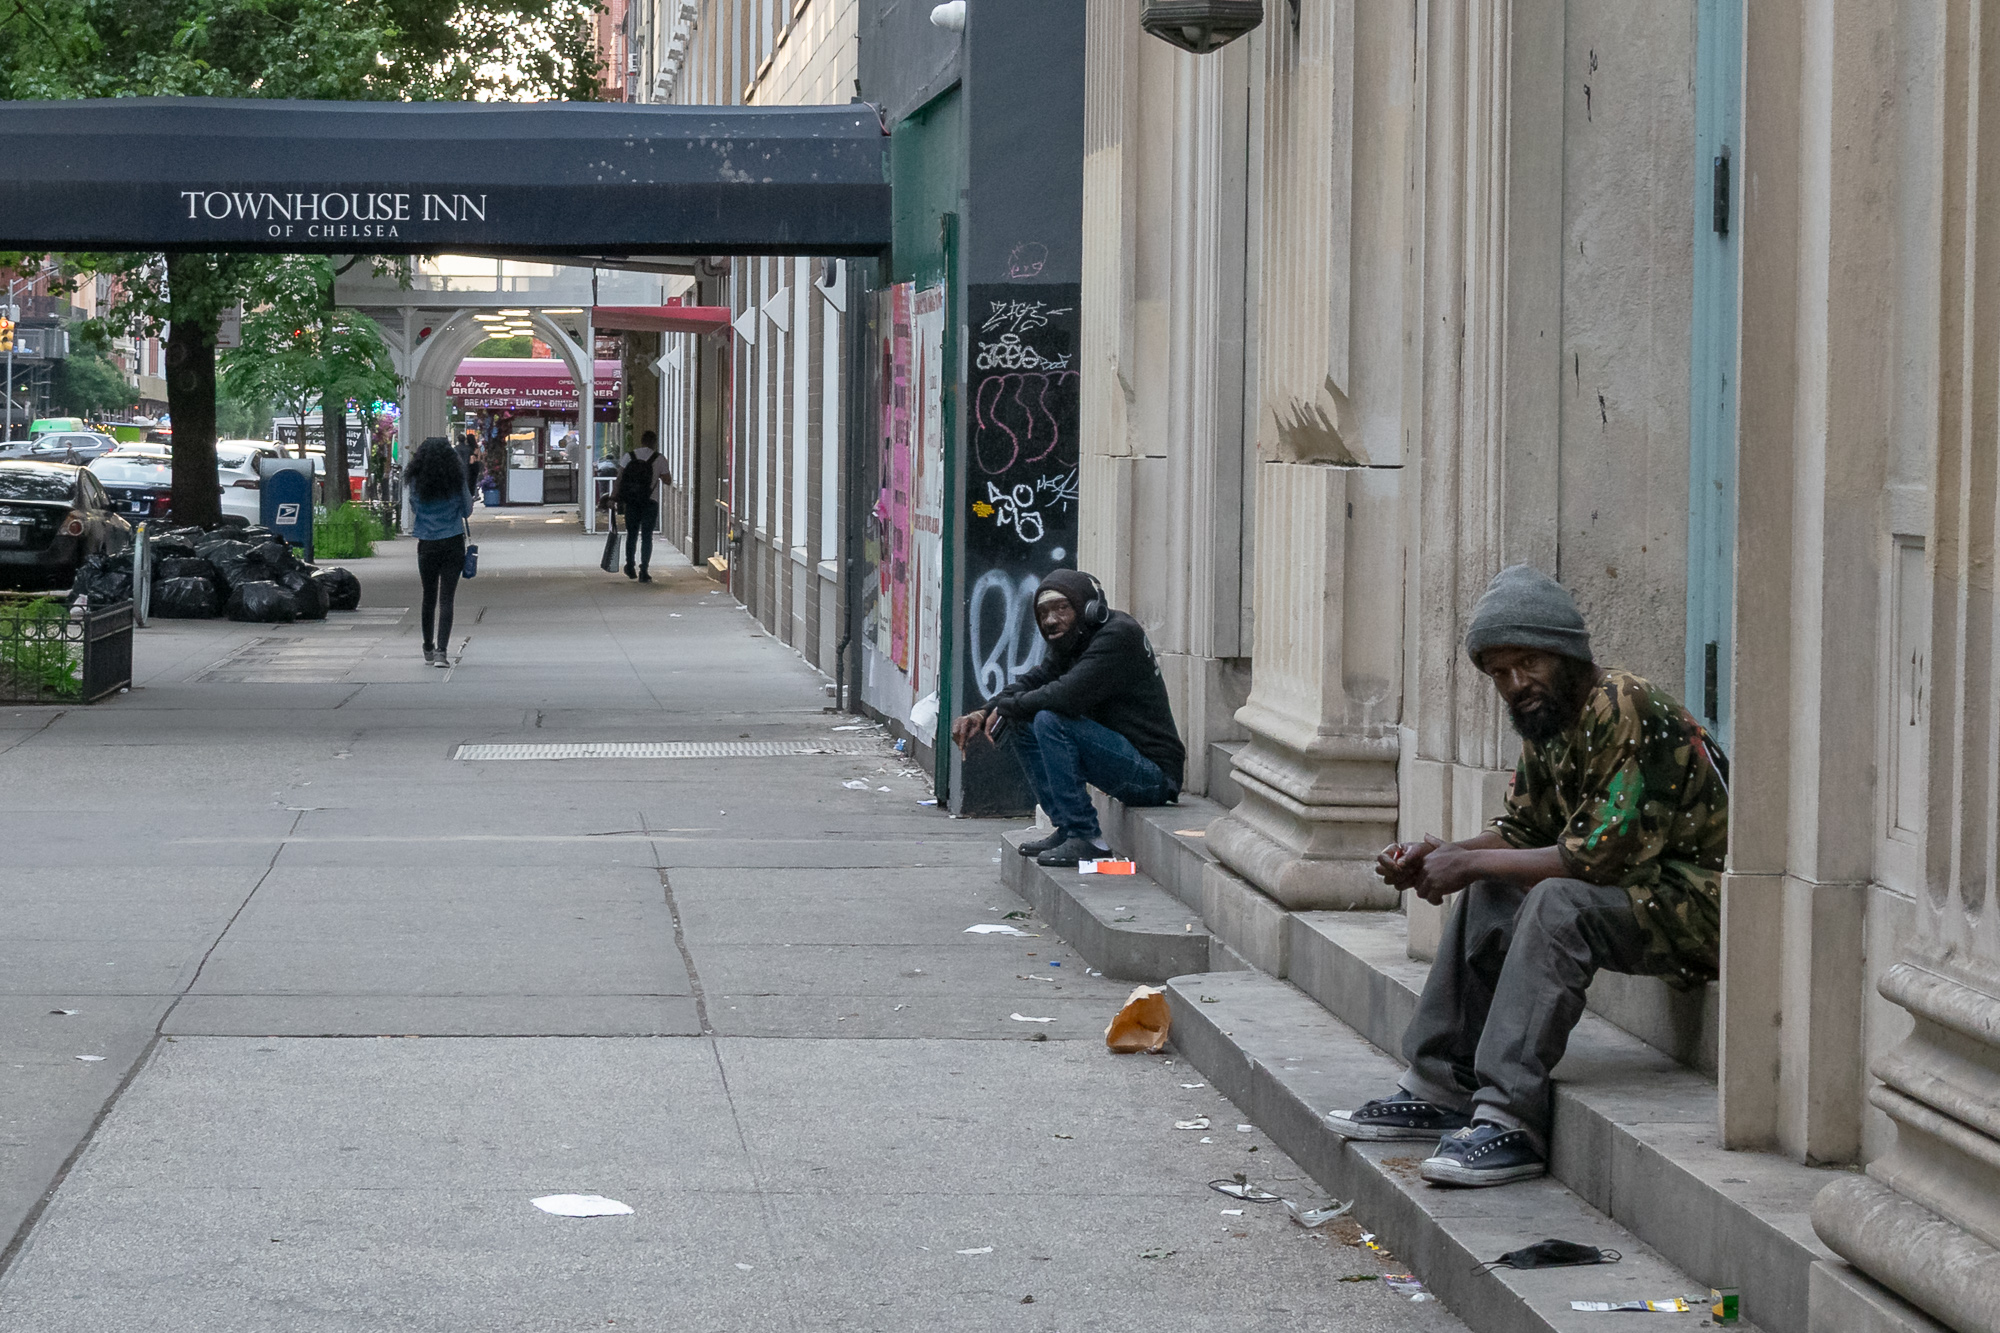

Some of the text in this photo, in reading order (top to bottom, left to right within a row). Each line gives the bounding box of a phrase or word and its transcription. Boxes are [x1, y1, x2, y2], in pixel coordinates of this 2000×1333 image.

[181, 191, 487, 221] TOWNHOUSE INN
[268, 225, 399, 237] OF CHELSEA
[526, 388, 563, 396] LUNCH
[571, 389, 613, 397] DNER
[464, 398, 508, 406] BREAKFAST
